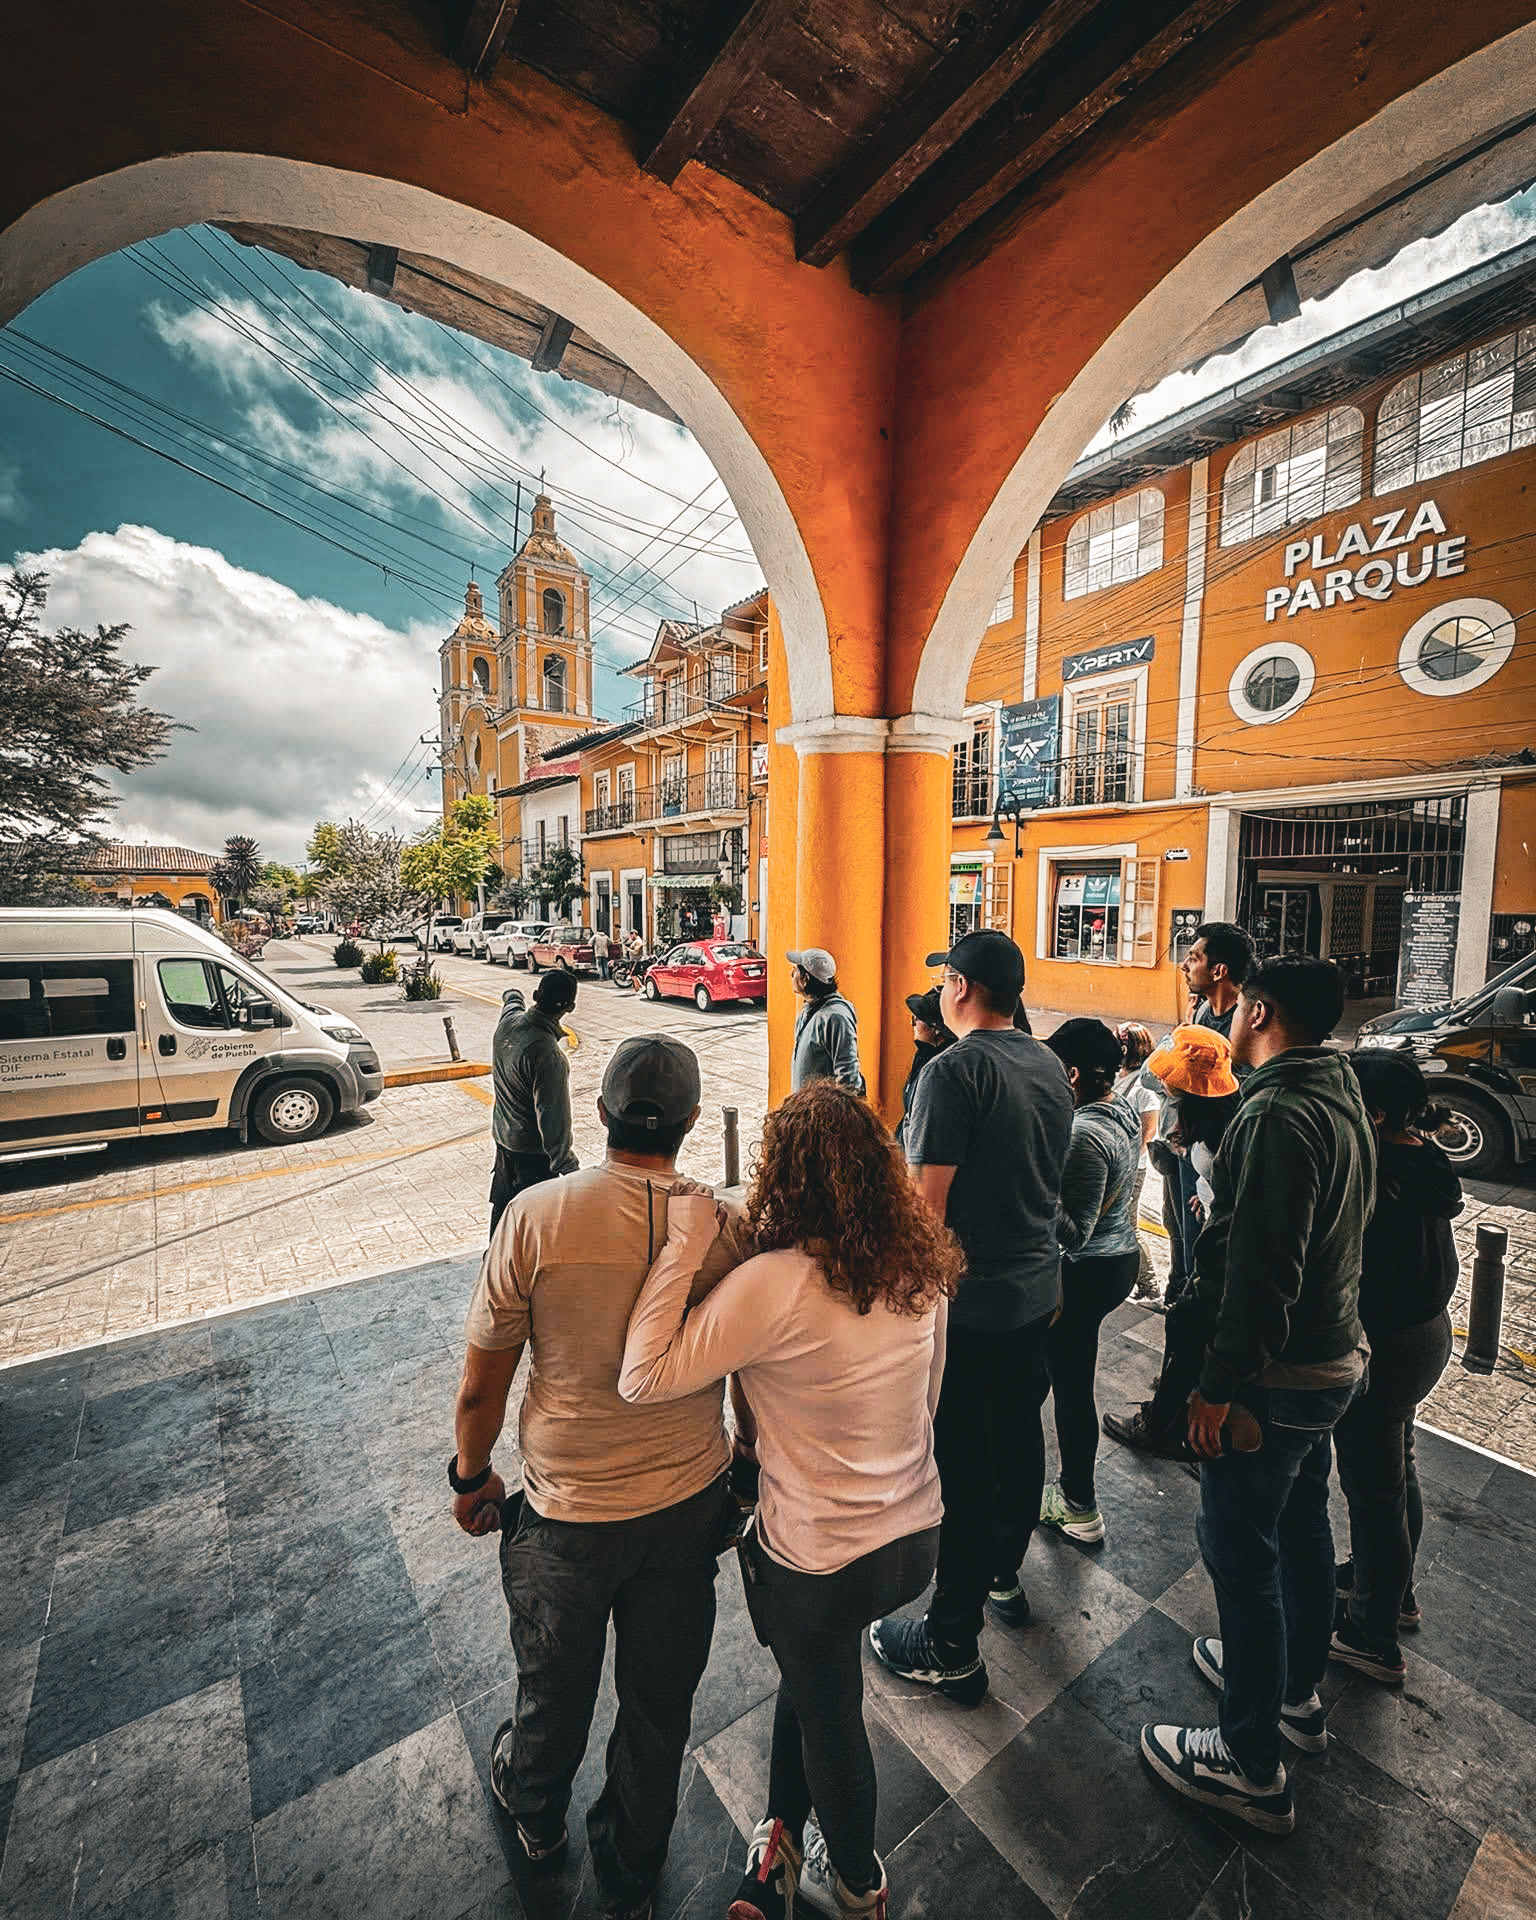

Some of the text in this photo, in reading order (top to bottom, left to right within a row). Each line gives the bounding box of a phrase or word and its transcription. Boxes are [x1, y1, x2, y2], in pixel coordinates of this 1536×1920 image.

[1284, 500, 1447, 577] PLAZA
[1265, 536, 1467, 622] PARQUE
[211, 1043, 254, 1052] Gobierno
[0, 1048, 95, 1063] Sistema Estatal
[226, 1050, 257, 1058] Puebla
[0, 1064, 22, 1073] DIF
[44, 1071, 67, 1079] Puebla
